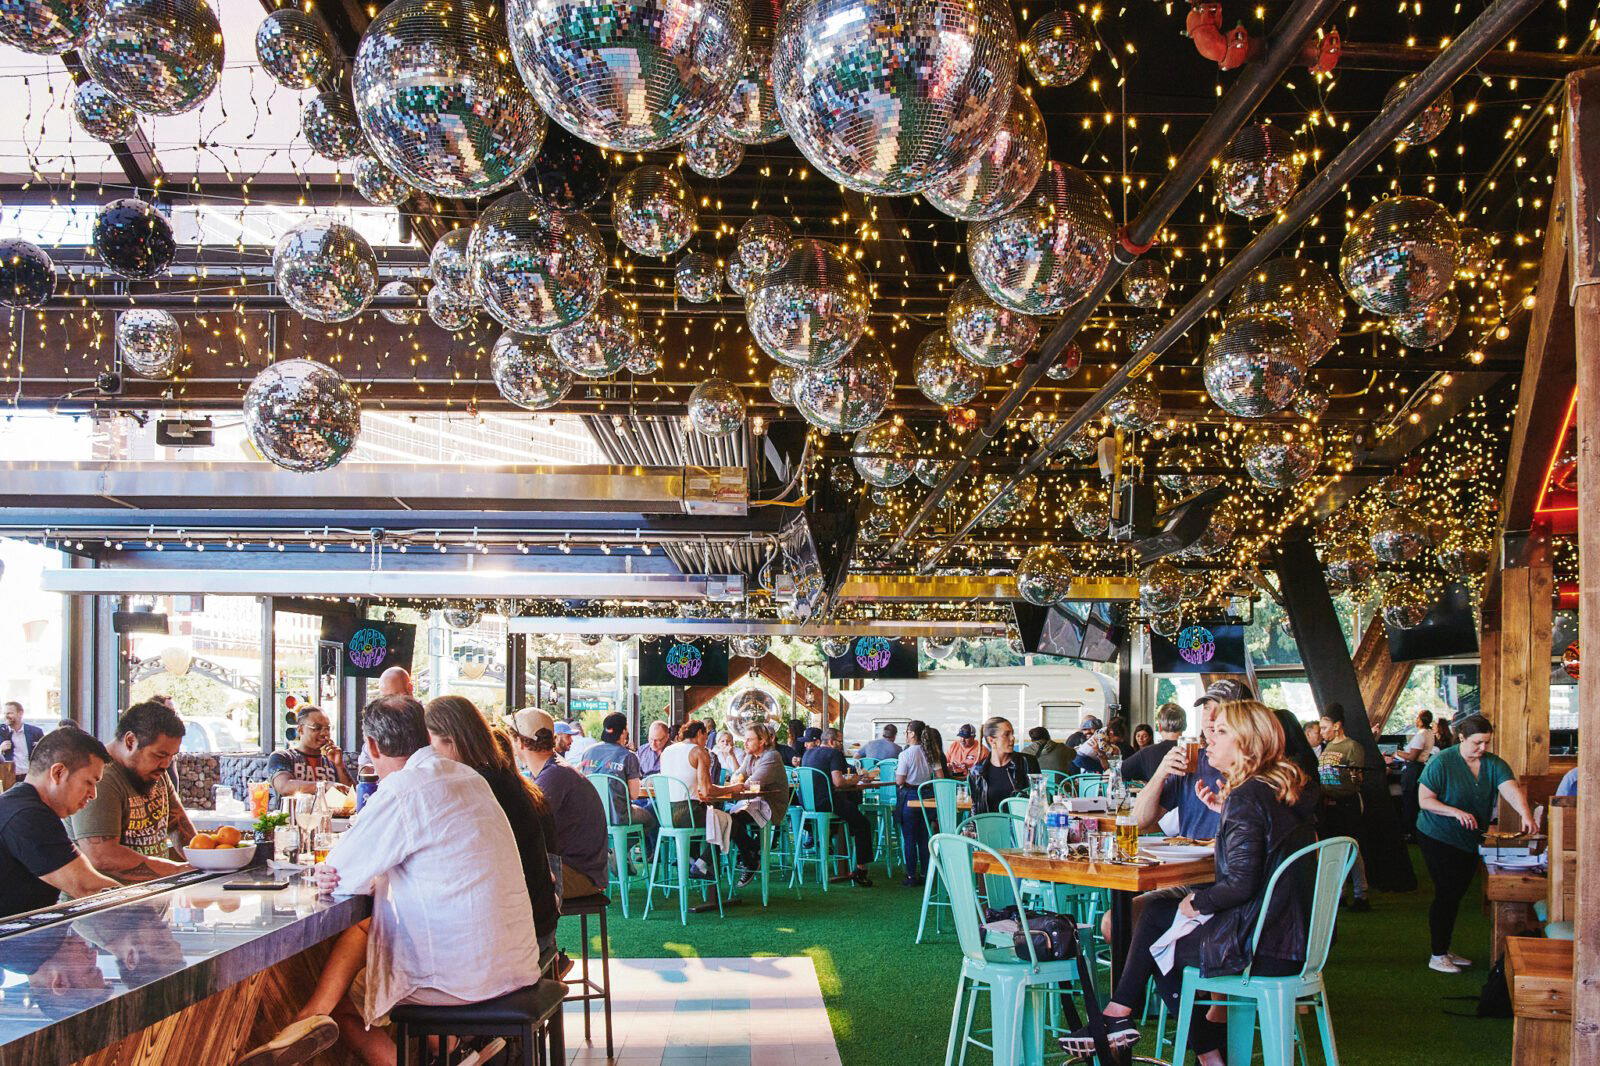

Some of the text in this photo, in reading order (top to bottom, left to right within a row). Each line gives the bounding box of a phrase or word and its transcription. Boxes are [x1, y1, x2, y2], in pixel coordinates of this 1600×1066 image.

[349, 628, 387, 651] HAPPY
[1178, 625, 1215, 648] HAPPY
[666, 643, 702, 664] HAPPY
[582, 701, 598, 710] Vegas
[294, 762, 336, 783] BASS
